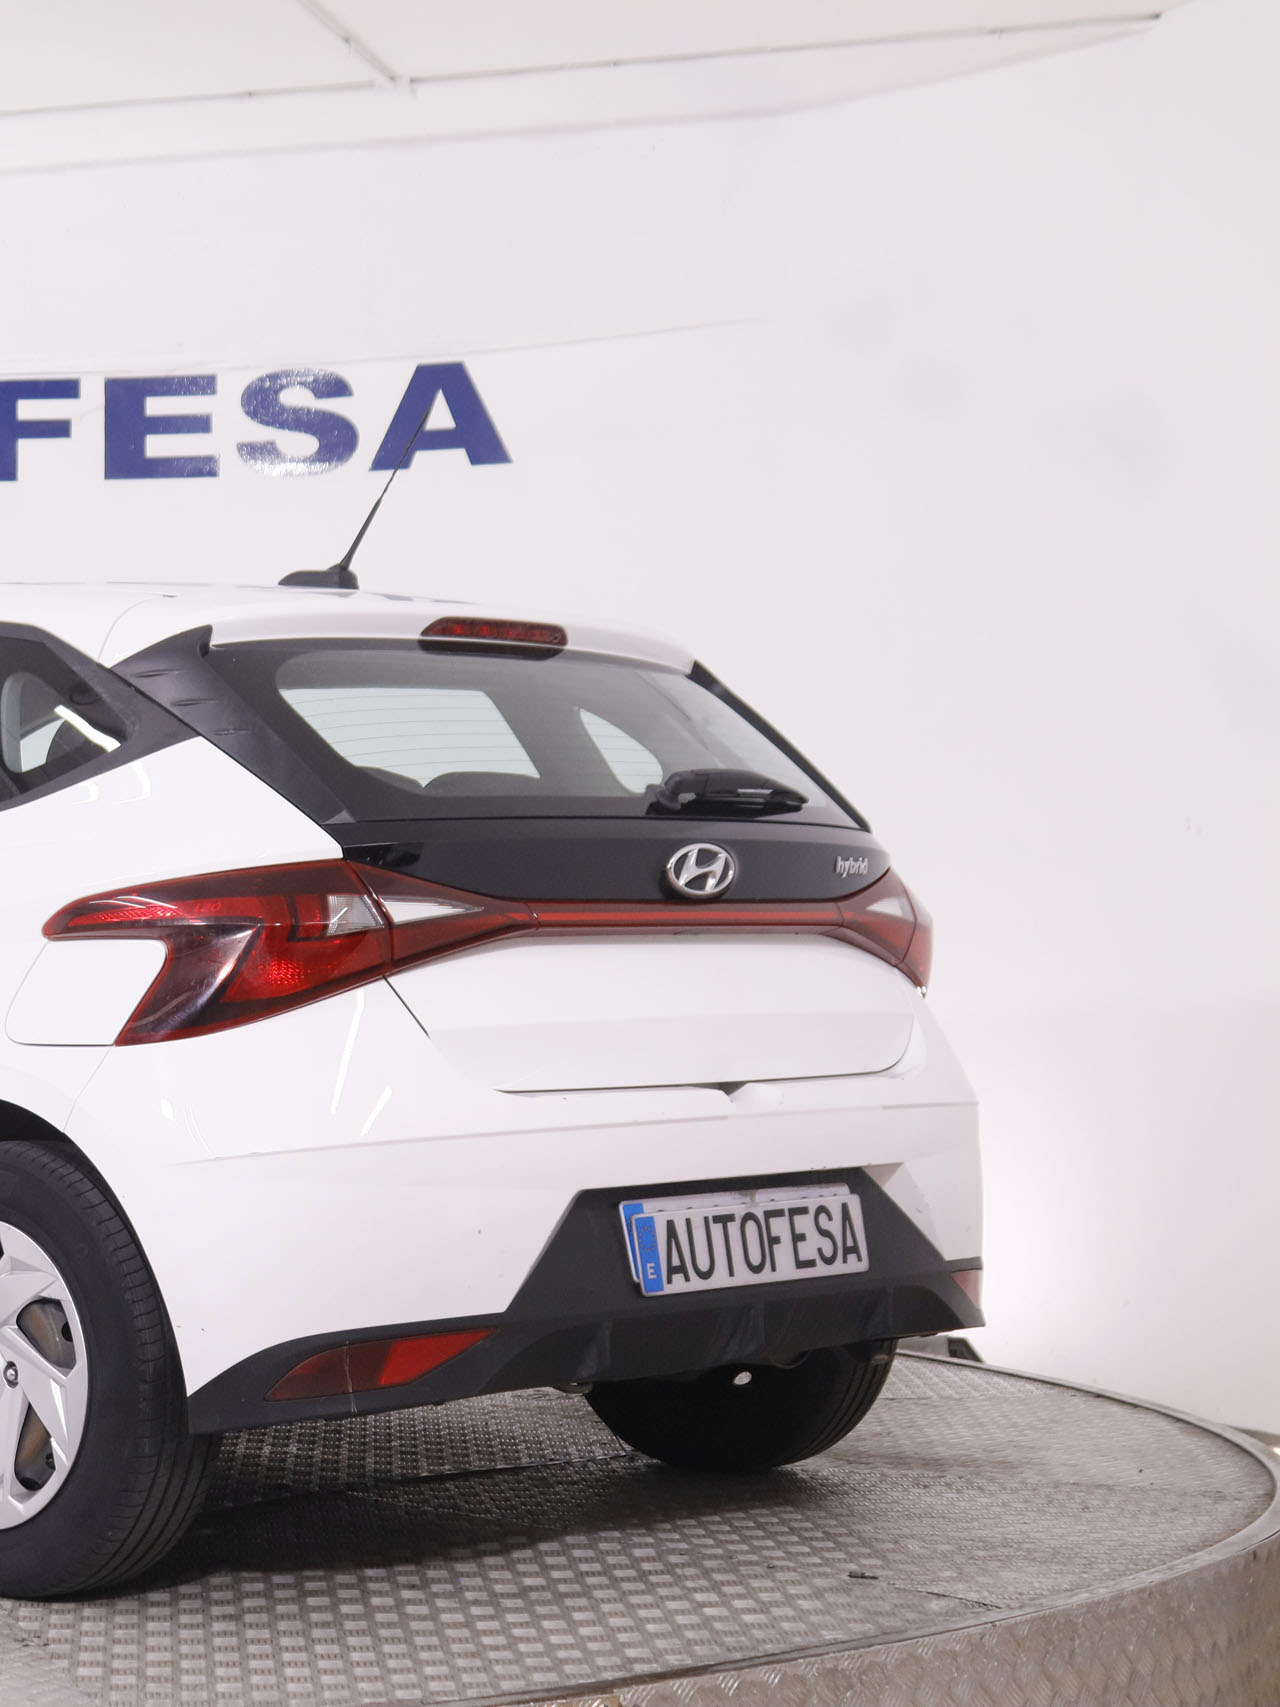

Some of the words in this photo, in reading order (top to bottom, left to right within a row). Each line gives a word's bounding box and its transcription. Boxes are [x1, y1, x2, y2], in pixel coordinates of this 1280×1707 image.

[835, 855, 869, 878] hybrid
[666, 1202, 863, 1285] AUTOFESA
[646, 1262, 658, 1280] E
